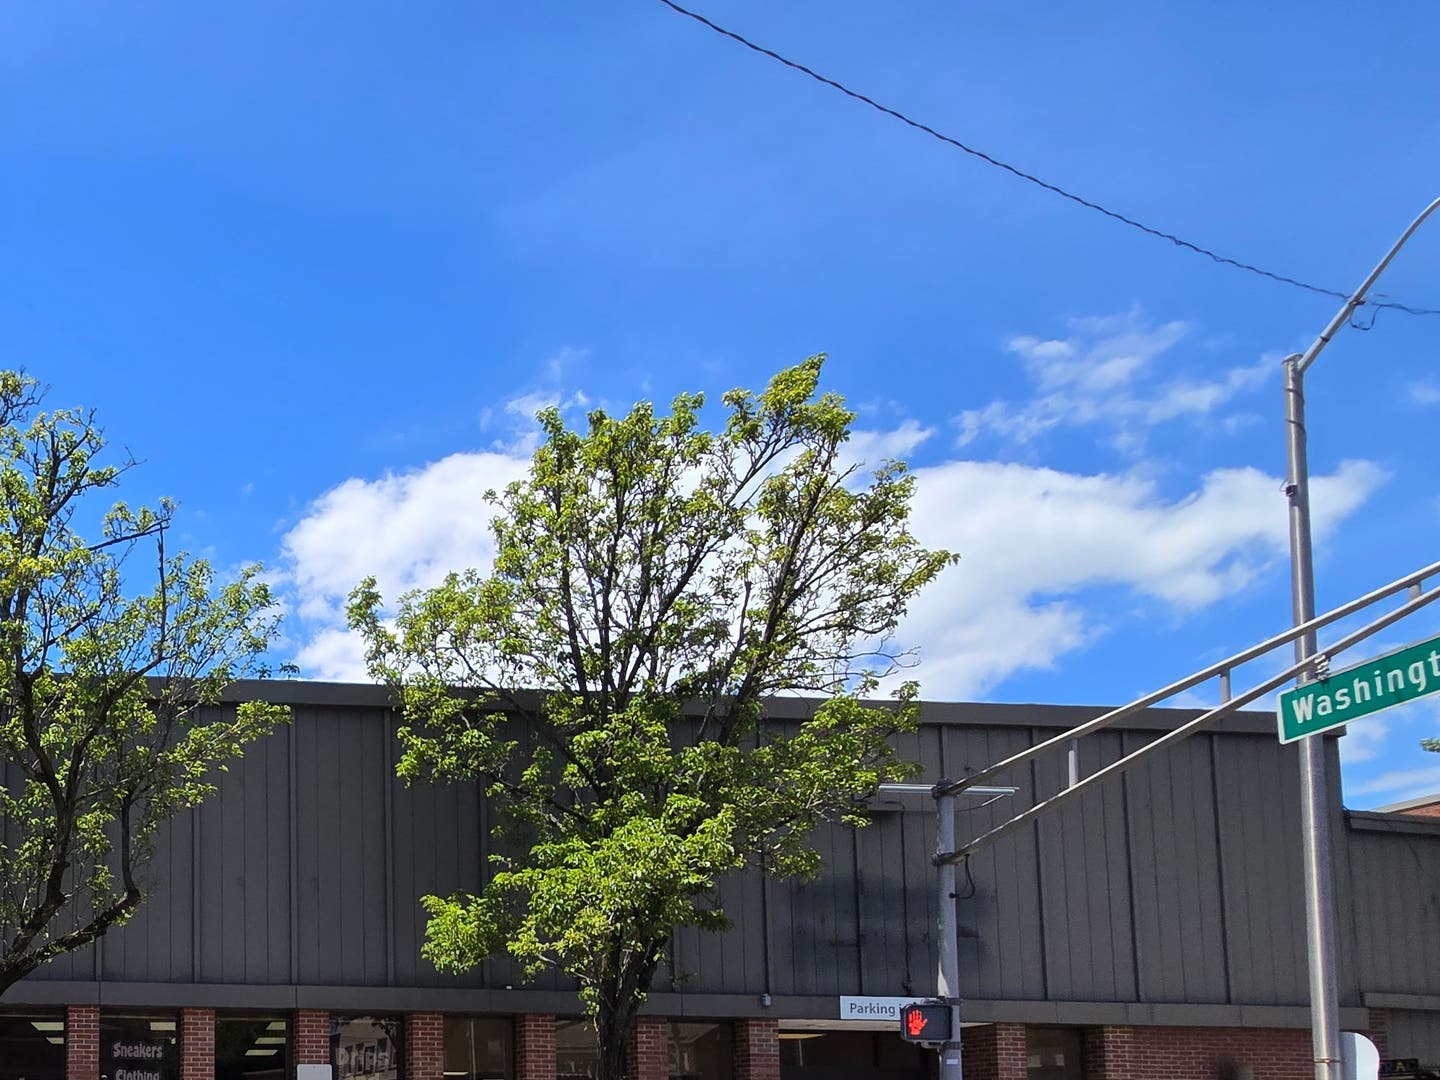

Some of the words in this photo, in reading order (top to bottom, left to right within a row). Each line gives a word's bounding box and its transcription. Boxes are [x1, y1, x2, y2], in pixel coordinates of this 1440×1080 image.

[1292, 650, 1440, 724] Washingt
[849, 1003, 896, 1017] Parking
[113, 1042, 163, 1058] Sneakers
